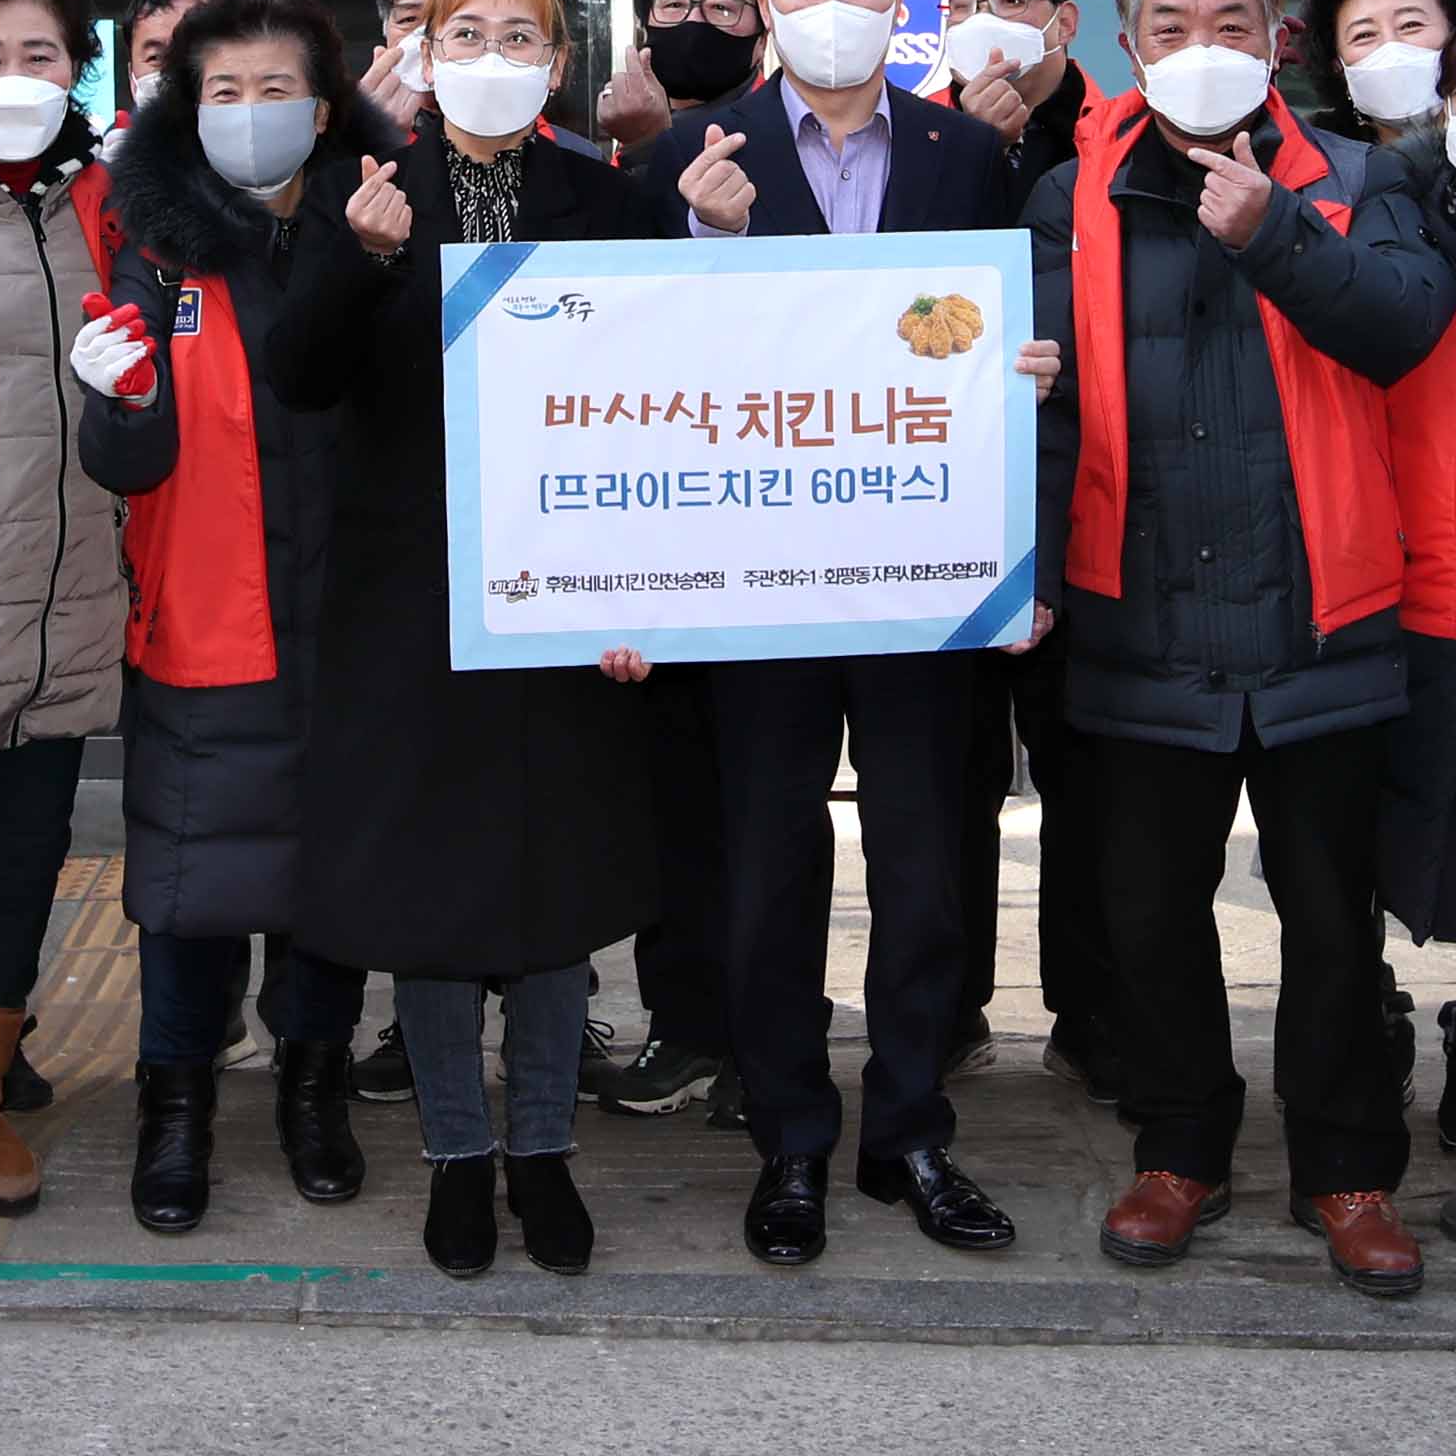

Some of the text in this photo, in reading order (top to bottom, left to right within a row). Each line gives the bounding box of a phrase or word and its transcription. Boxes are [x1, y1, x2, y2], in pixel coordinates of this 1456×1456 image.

[558, 293, 595, 322] 동구
[545, 387, 953, 448] 바사삭 치킨 나눔
[647, 571, 726, 591] 인천송현점
